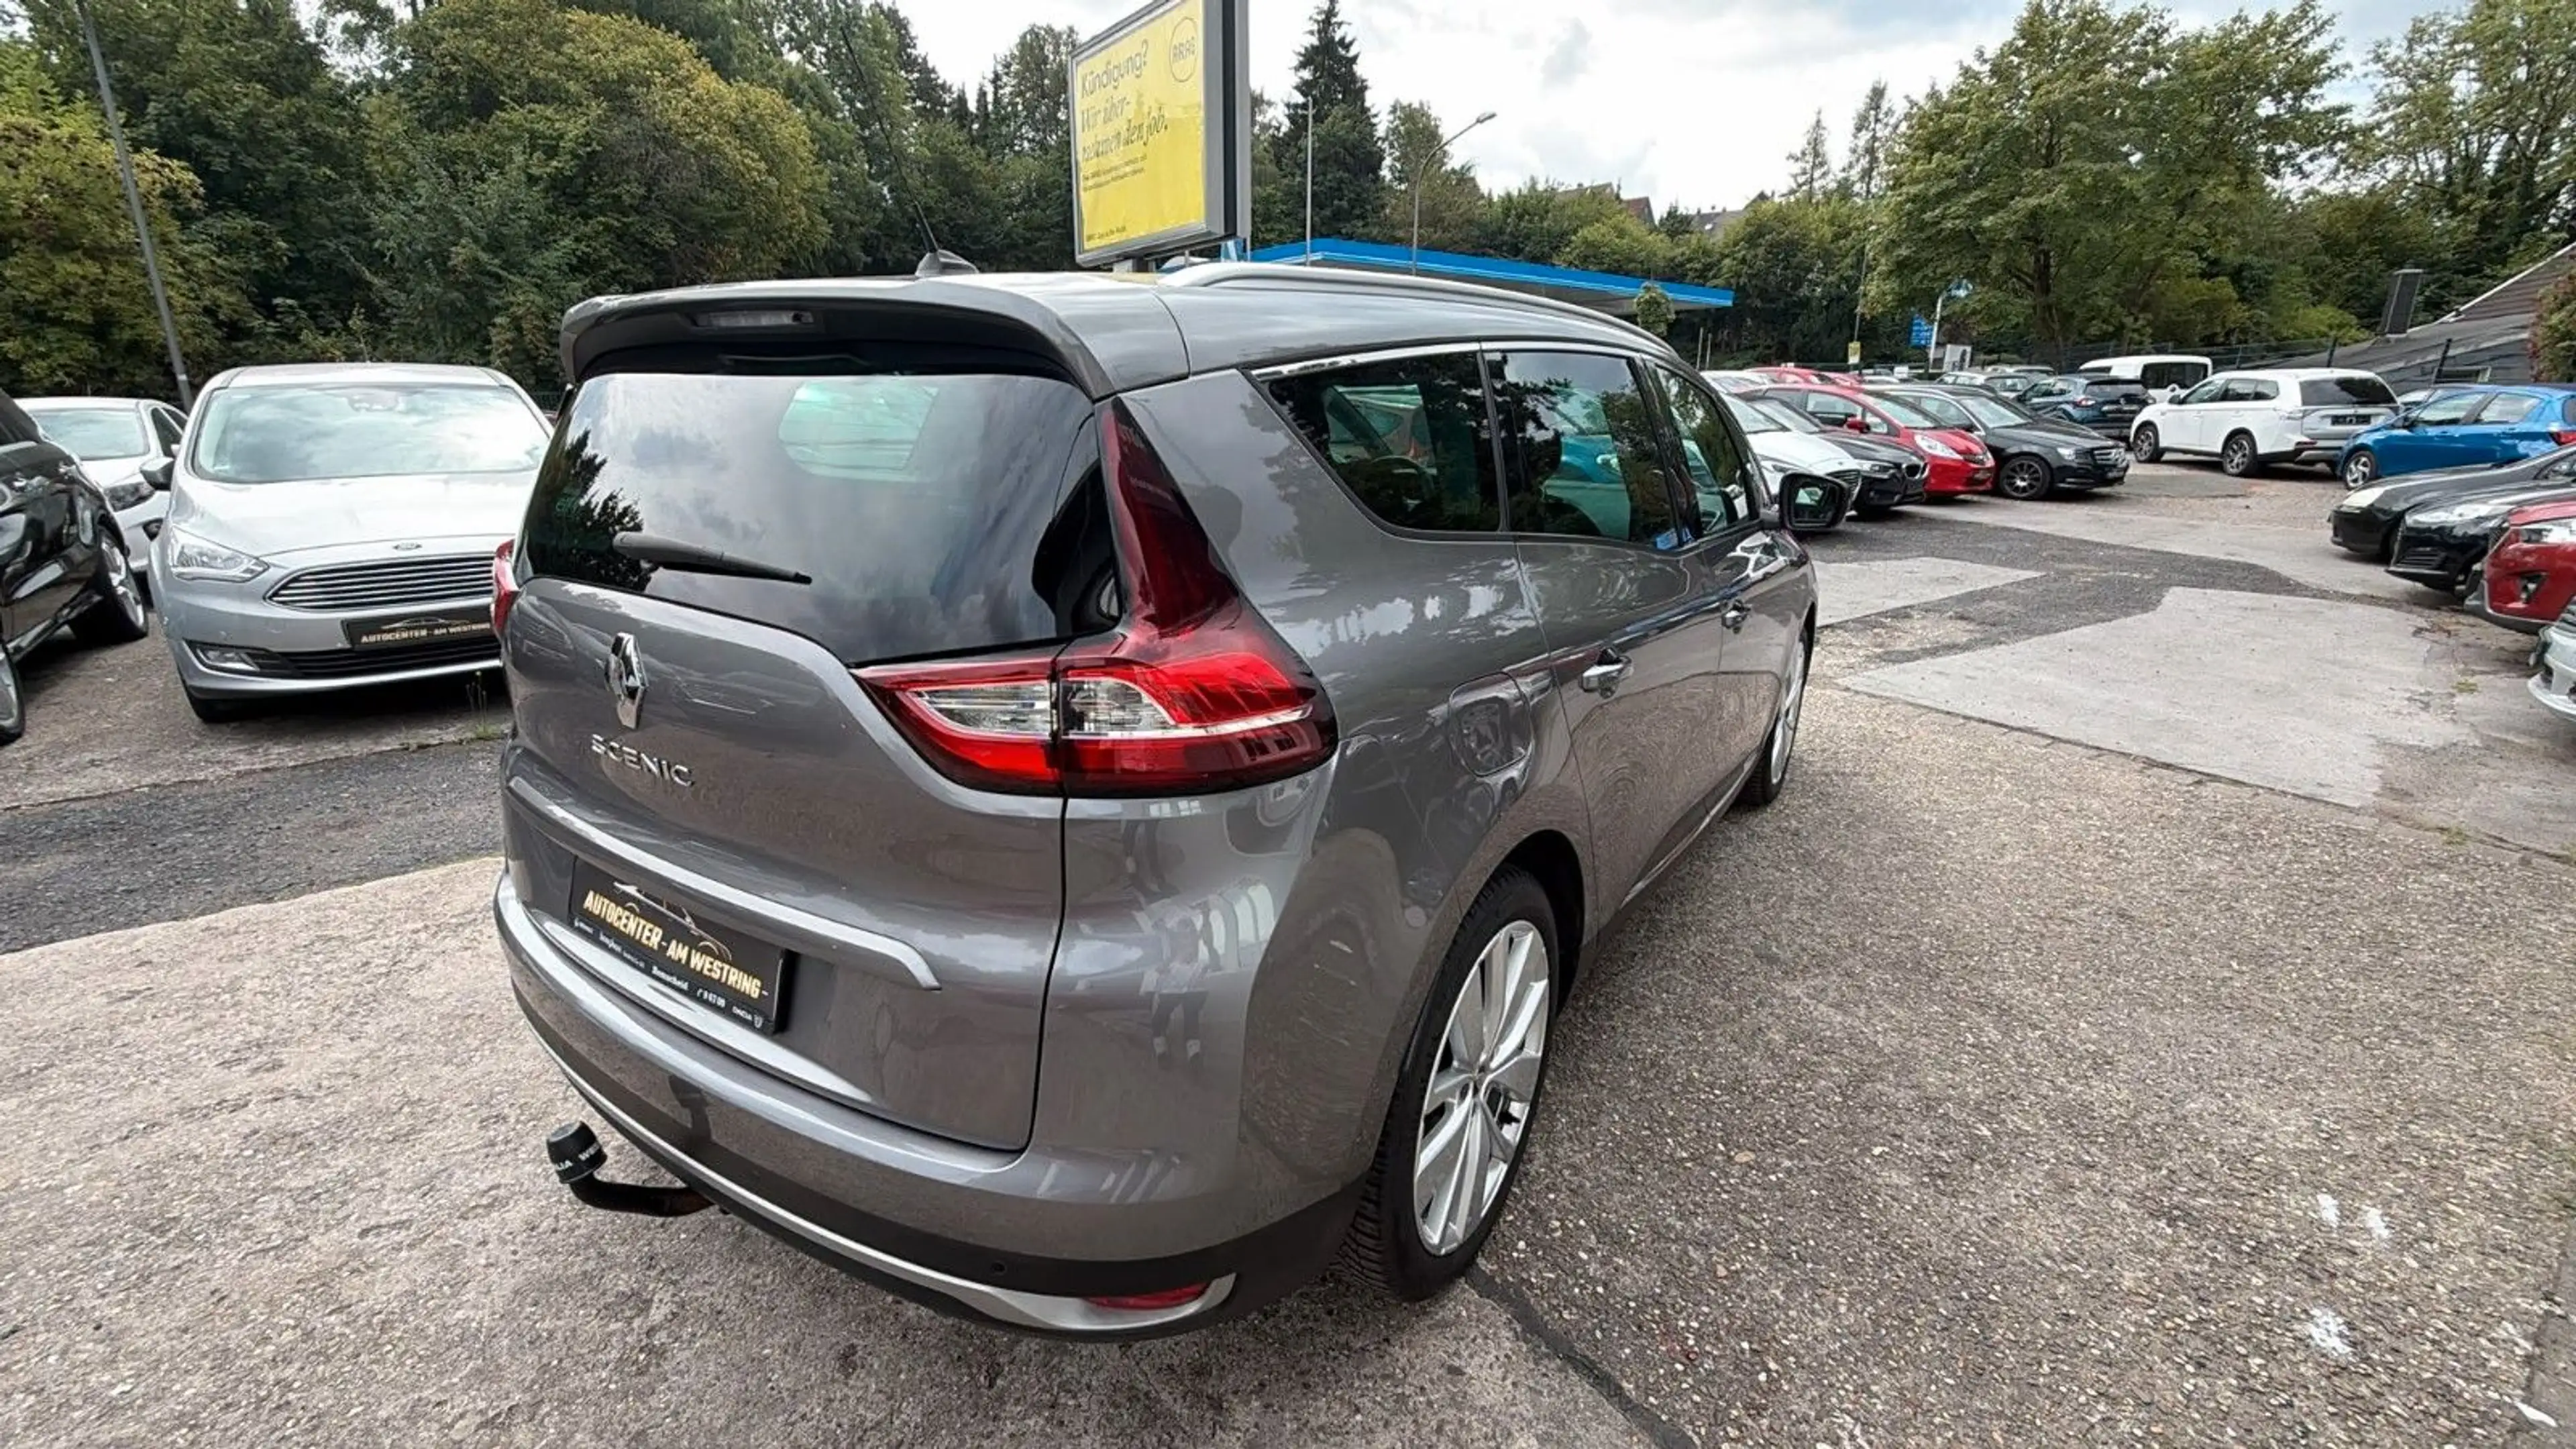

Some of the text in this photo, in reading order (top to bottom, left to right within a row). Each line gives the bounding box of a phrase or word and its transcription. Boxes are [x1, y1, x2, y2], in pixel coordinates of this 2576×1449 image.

[1081, 38, 1148, 99] Kündigung?
[591, 733, 694, 787] SCENIC
[583, 890, 664, 951] AUTOCENTER
[665, 939, 690, 965] AM
[690, 949, 762, 1000] WESTRING
